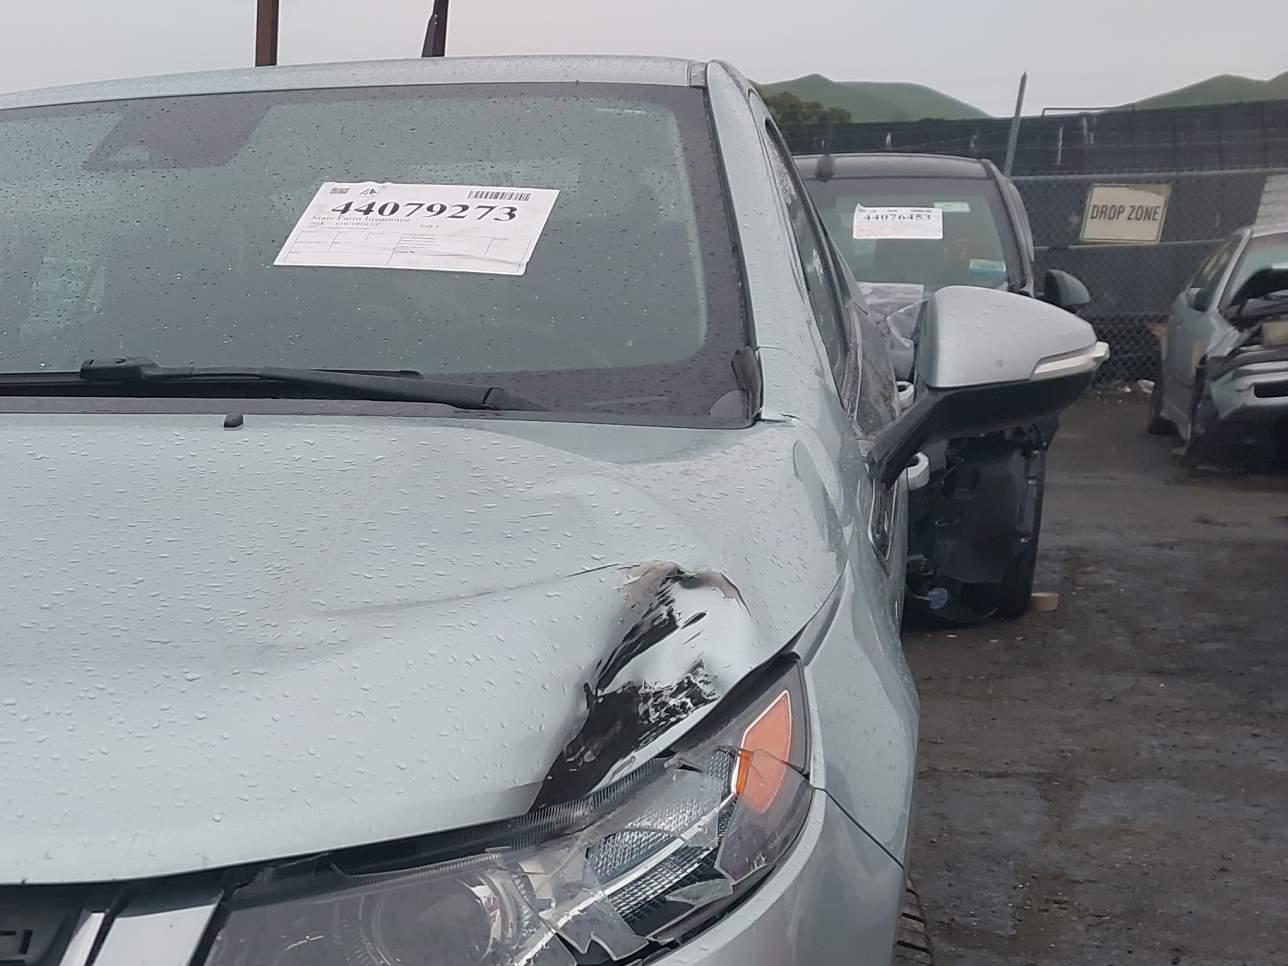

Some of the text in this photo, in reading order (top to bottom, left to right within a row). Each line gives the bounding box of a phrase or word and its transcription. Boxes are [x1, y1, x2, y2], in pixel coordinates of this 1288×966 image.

[331, 200, 519, 223] 44079273
[1090, 204, 1161, 221] DROP ZONE
